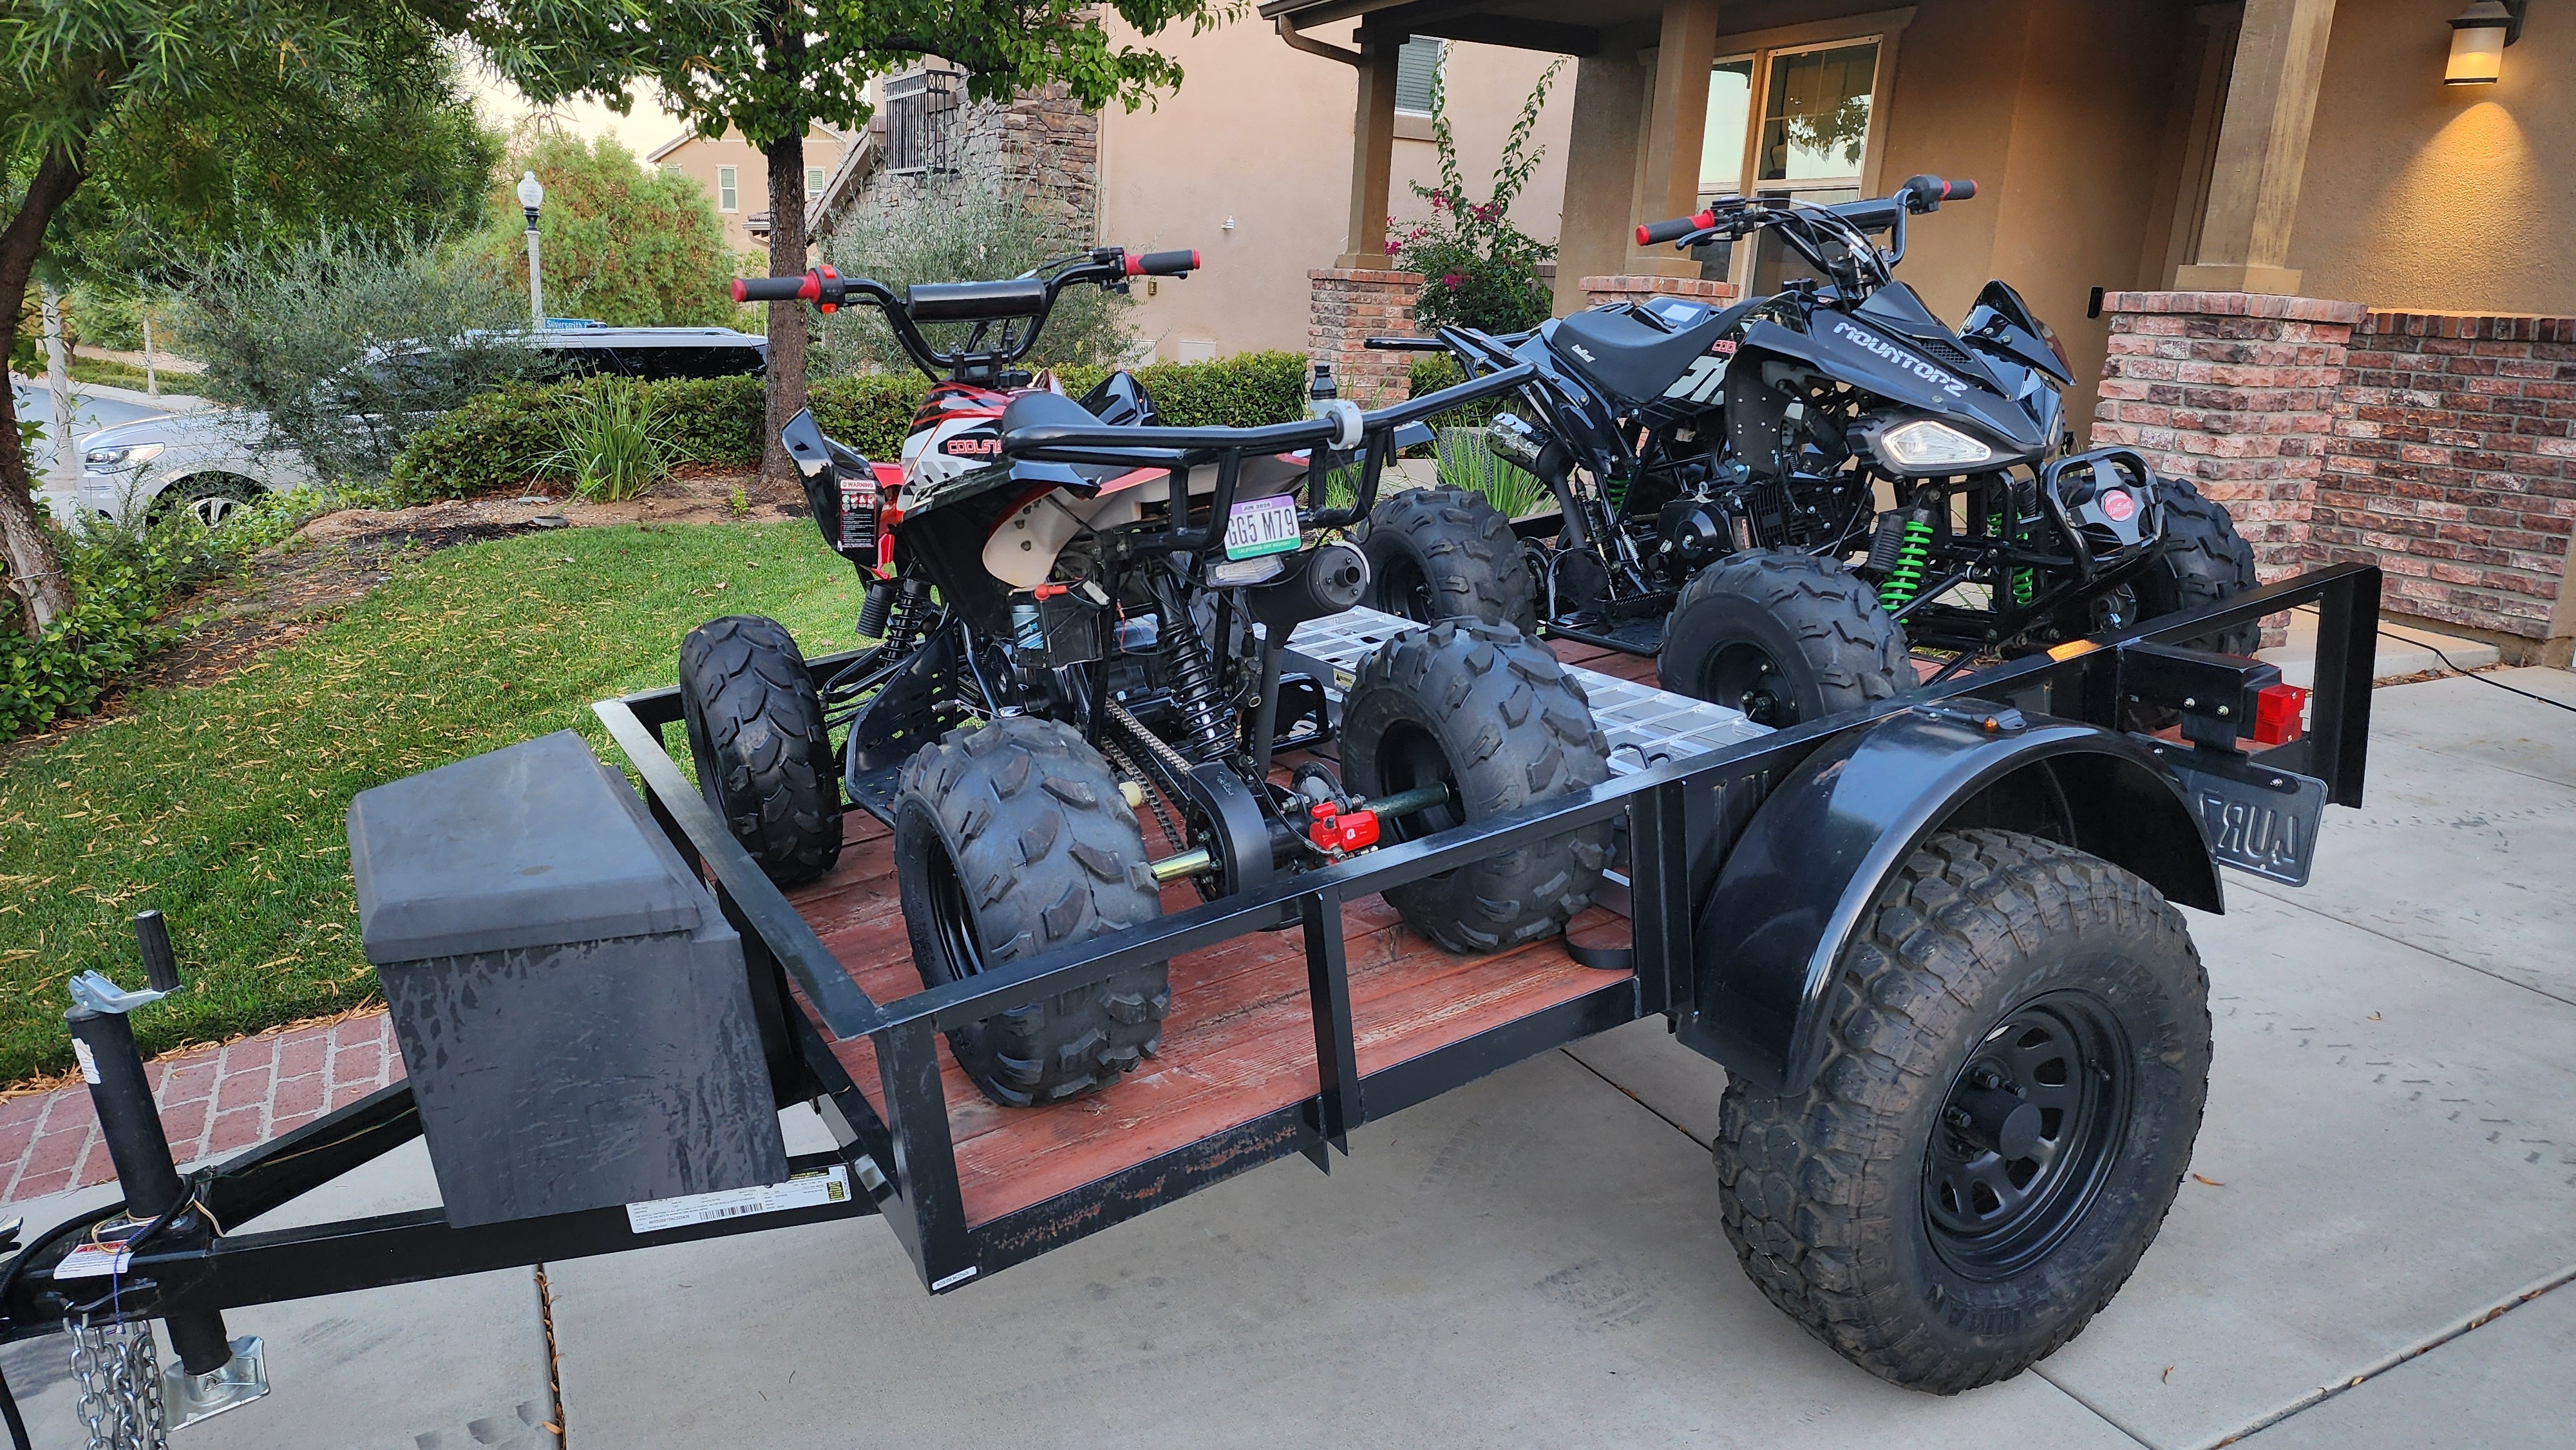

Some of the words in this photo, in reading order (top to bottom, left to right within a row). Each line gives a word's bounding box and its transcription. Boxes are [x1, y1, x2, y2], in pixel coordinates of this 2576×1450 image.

[547, 320, 583, 329] Silversmith
[1227, 514, 1258, 547] GG5
[1260, 508, 1295, 541] M79
